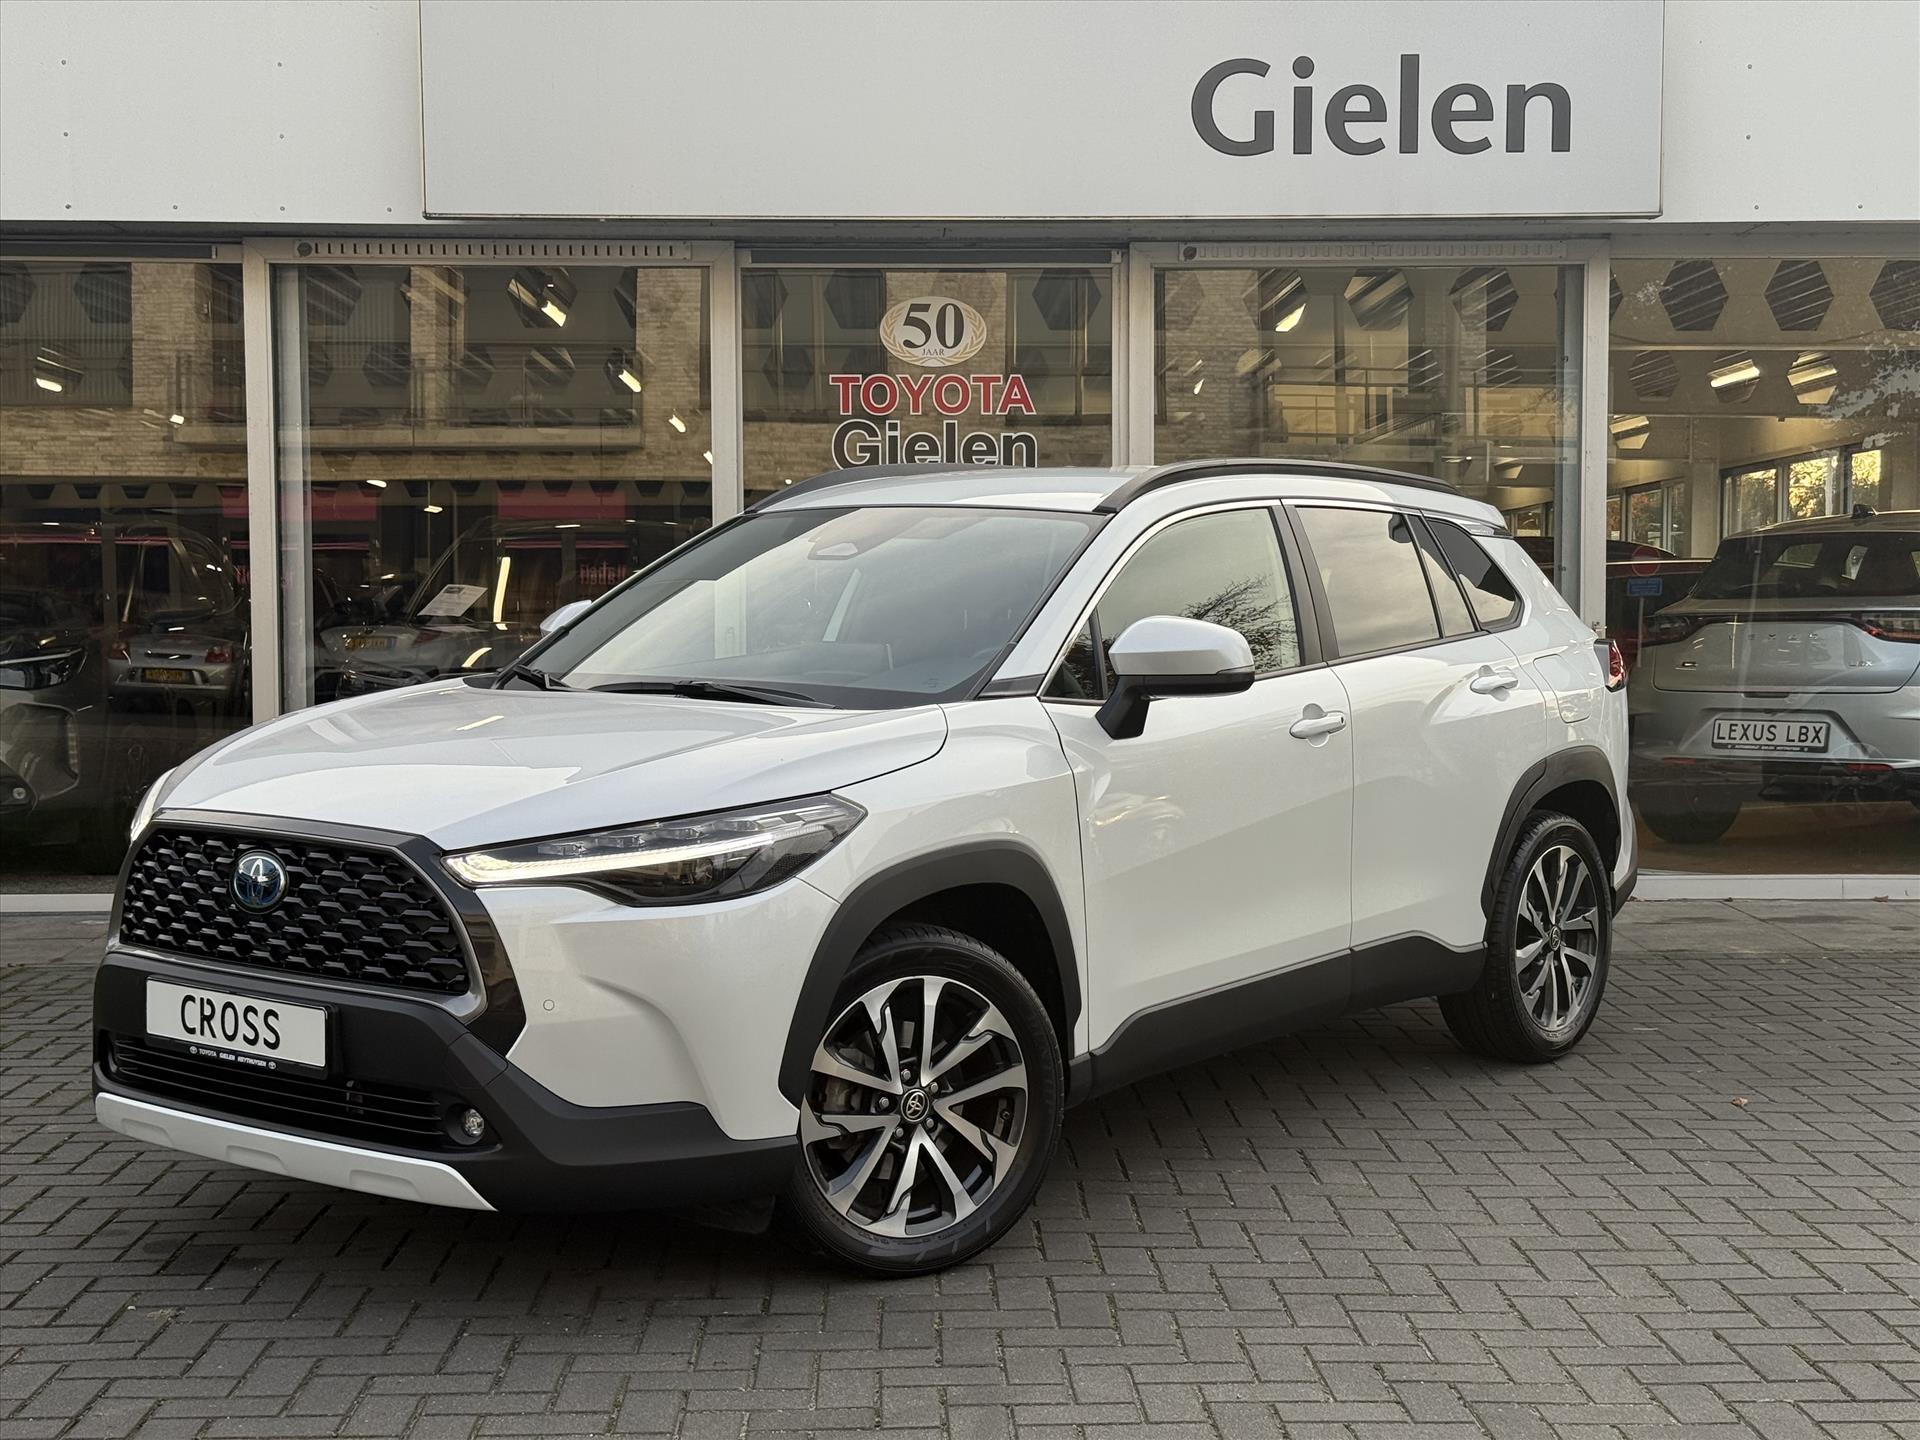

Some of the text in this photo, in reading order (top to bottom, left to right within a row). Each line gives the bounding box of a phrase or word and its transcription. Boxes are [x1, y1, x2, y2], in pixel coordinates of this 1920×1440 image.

[1191, 54, 1571, 157] Gielen
[902, 302, 965, 349] 50
[921, 348, 946, 356] JAAR
[829, 374, 1037, 415] TOYOTA
[832, 419, 1038, 470] Gielen
[1716, 723, 1823, 744] LEXUS LBX
[180, 994, 281, 1051] CROSS
[199, 1048, 217, 1058] TOYOTA
